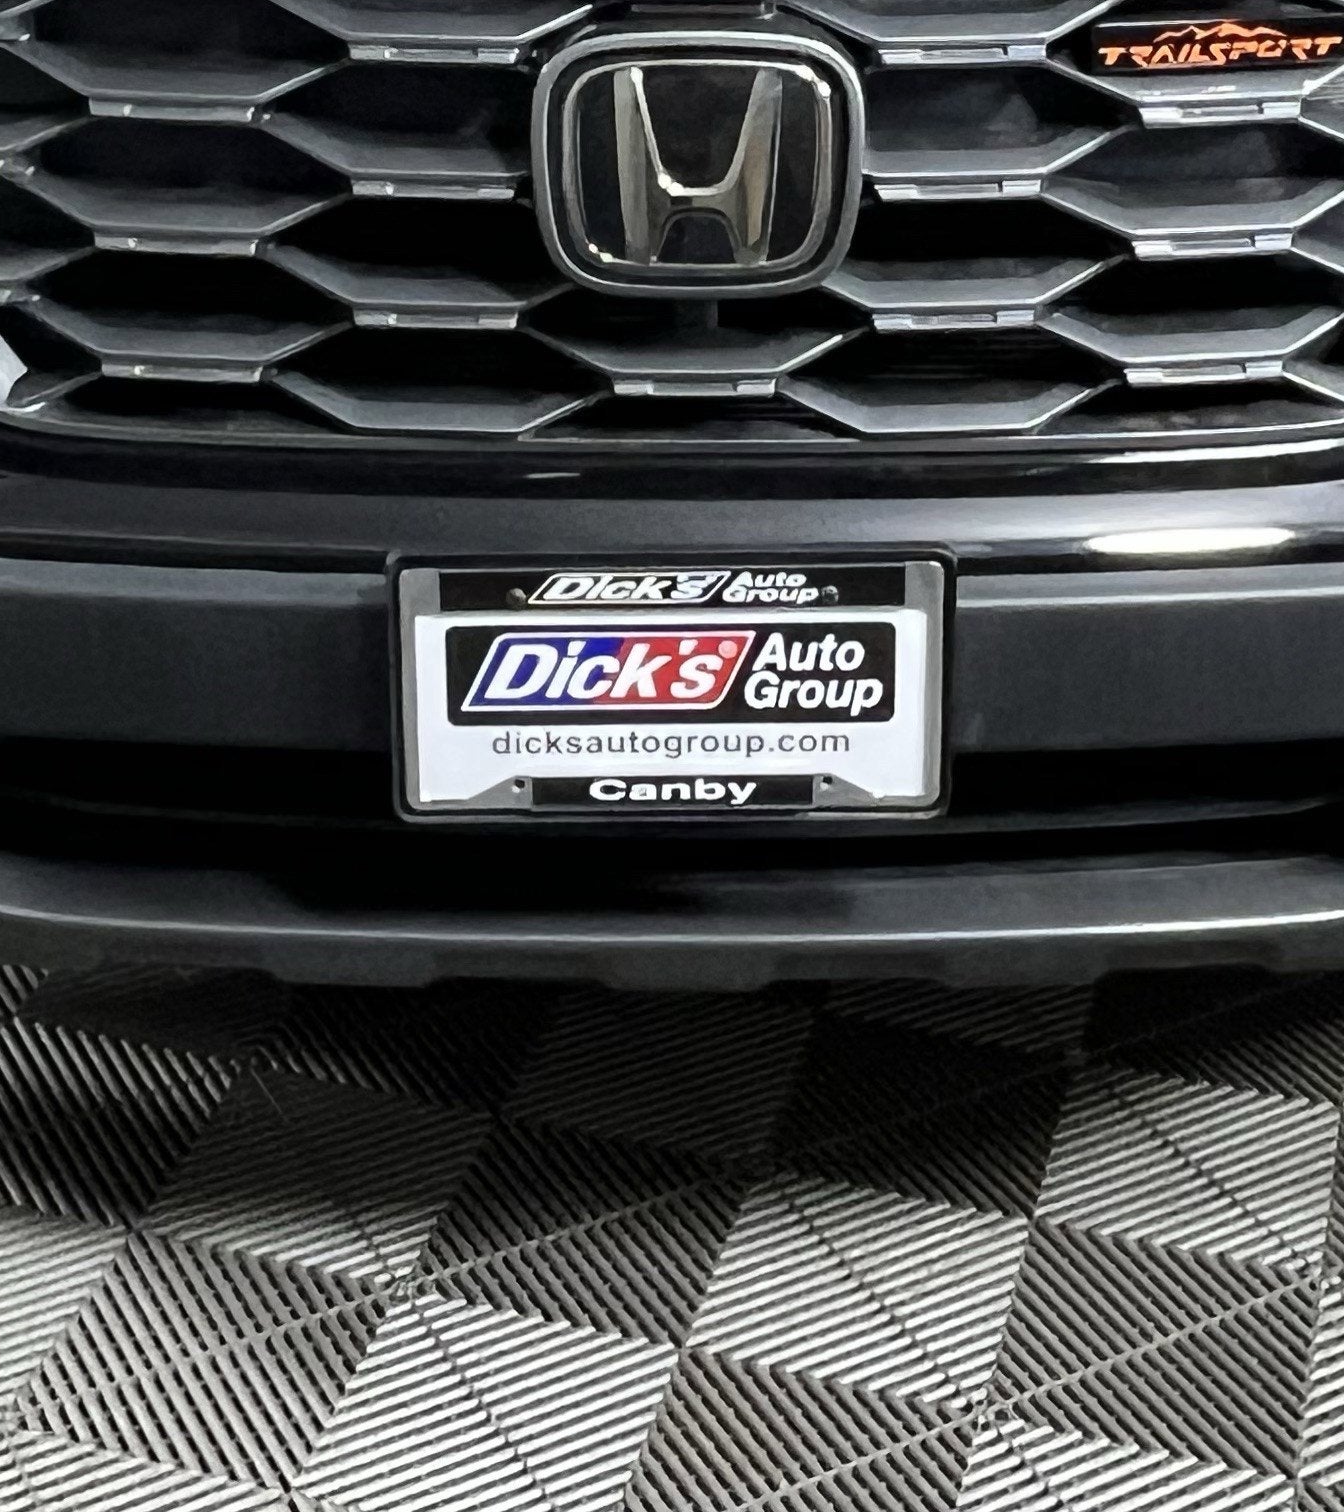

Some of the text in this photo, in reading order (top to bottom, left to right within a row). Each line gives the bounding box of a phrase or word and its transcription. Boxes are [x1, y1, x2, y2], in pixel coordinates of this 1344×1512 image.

[1098, 36, 1343, 68] TRAILSPORT
[734, 571, 807, 587] Auto
[722, 585, 819, 605] Group
[752, 632, 865, 672] Auto
[484, 639, 725, 700] Dick's
[744, 671, 883, 717] Group
[491, 730, 851, 758] dicksautogroup.com
[588, 777, 757, 806] Canby
